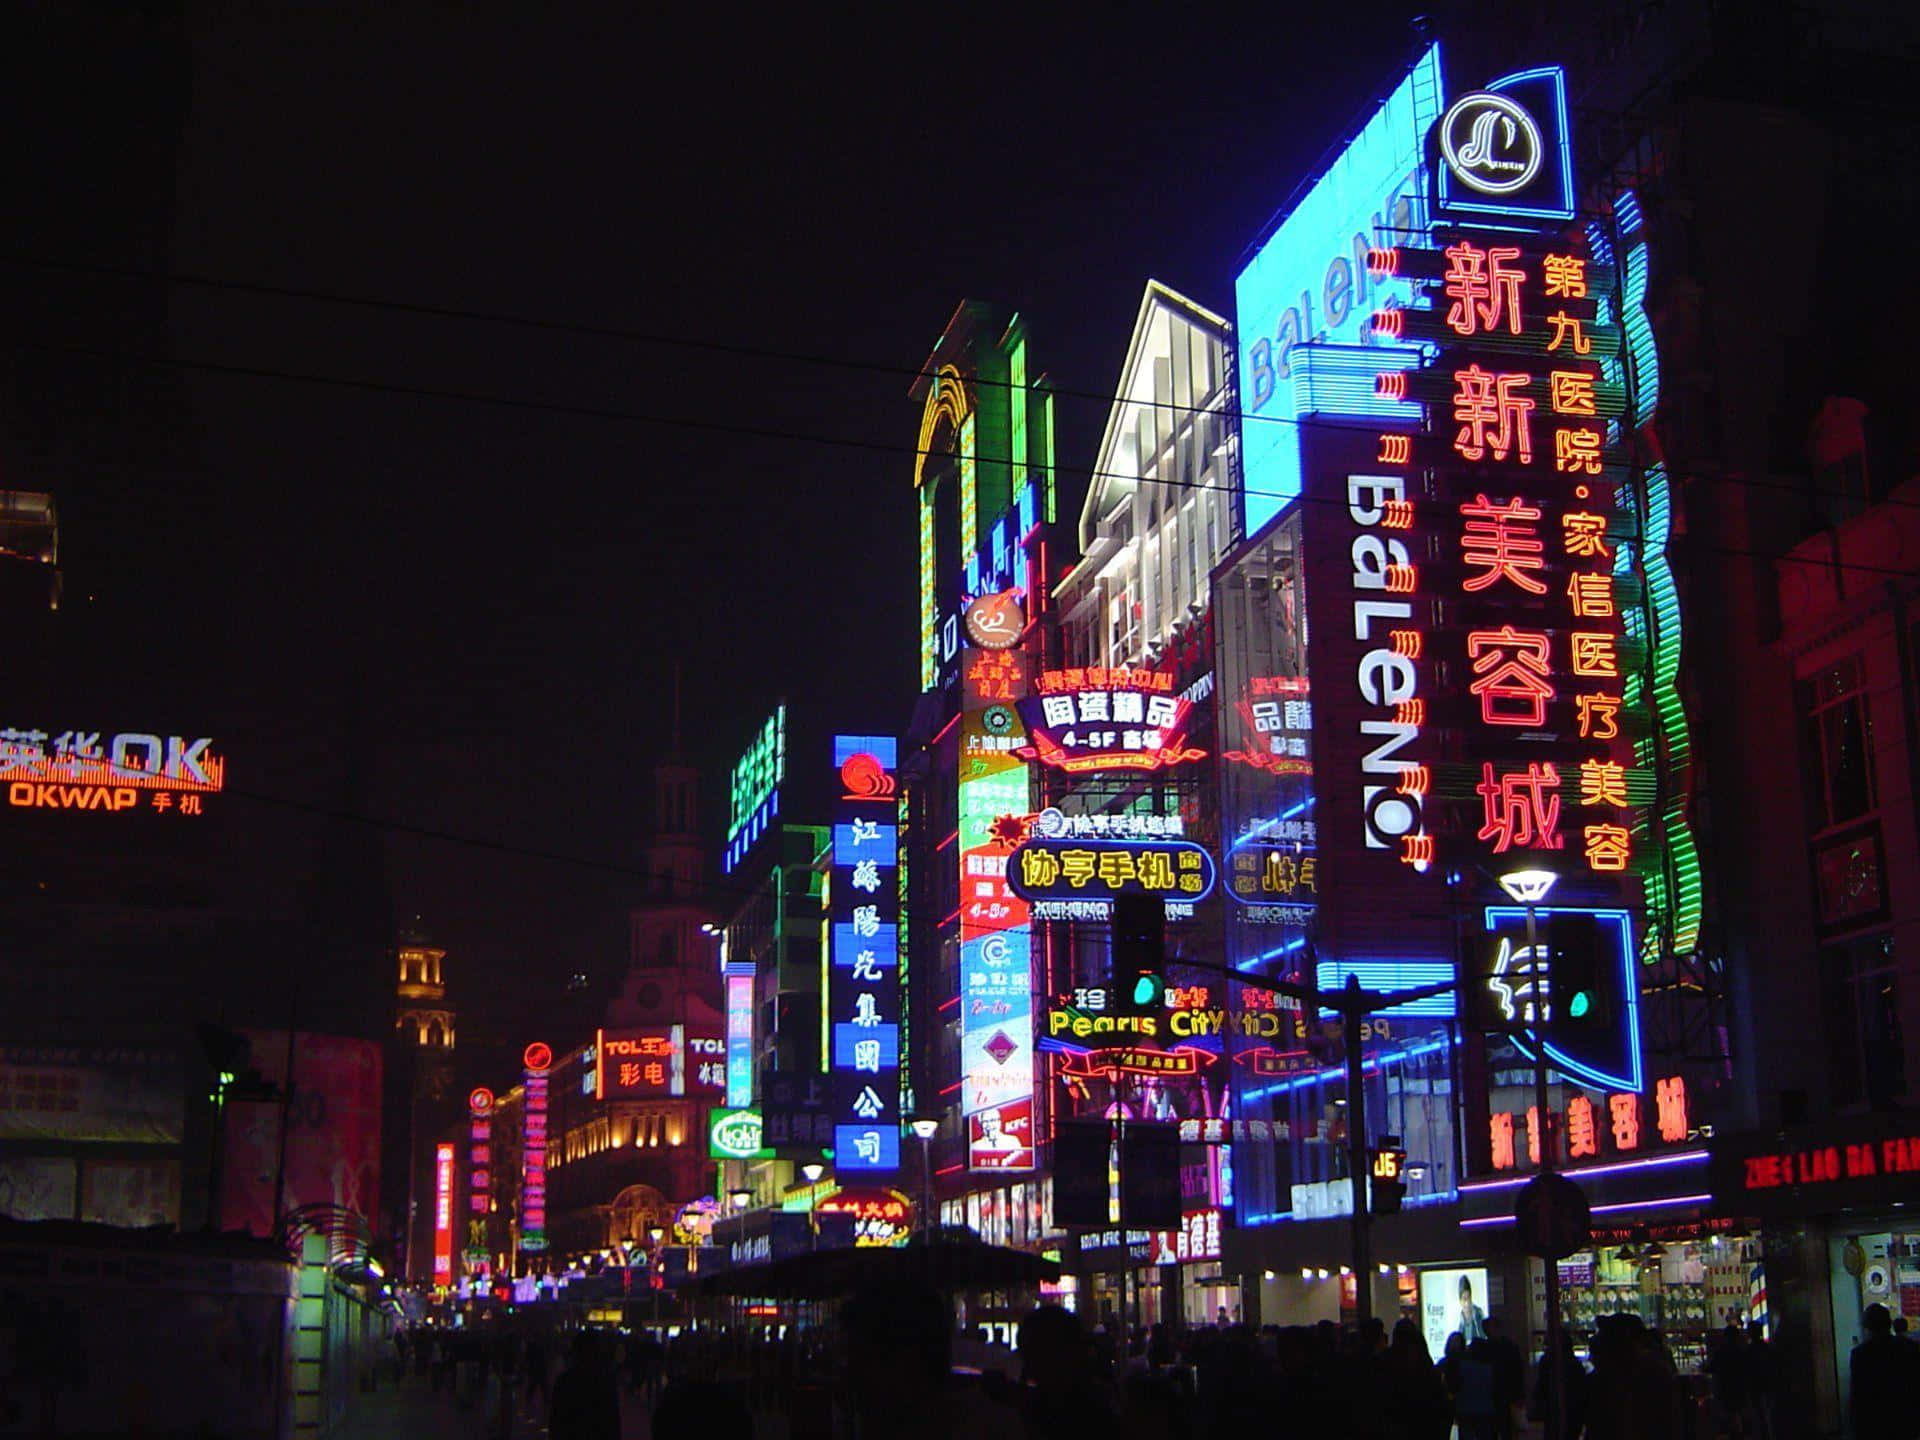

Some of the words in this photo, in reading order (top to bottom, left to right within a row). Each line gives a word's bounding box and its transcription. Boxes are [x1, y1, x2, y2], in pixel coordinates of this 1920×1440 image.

[1445, 241, 1564, 854] 新新美容城
[1063, 731, 1115, 750] 4-5F
[9, 782, 137, 811] OKWAP
[152, 792, 203, 816] 手机
[1022, 849, 1176, 890] 协亨手机
[1049, 1011, 1157, 1037] Pearls
[689, 1039, 725, 1054] TCL
[619, 1062, 665, 1087] 彩电
[1004, 1118, 1029, 1134] KFC
